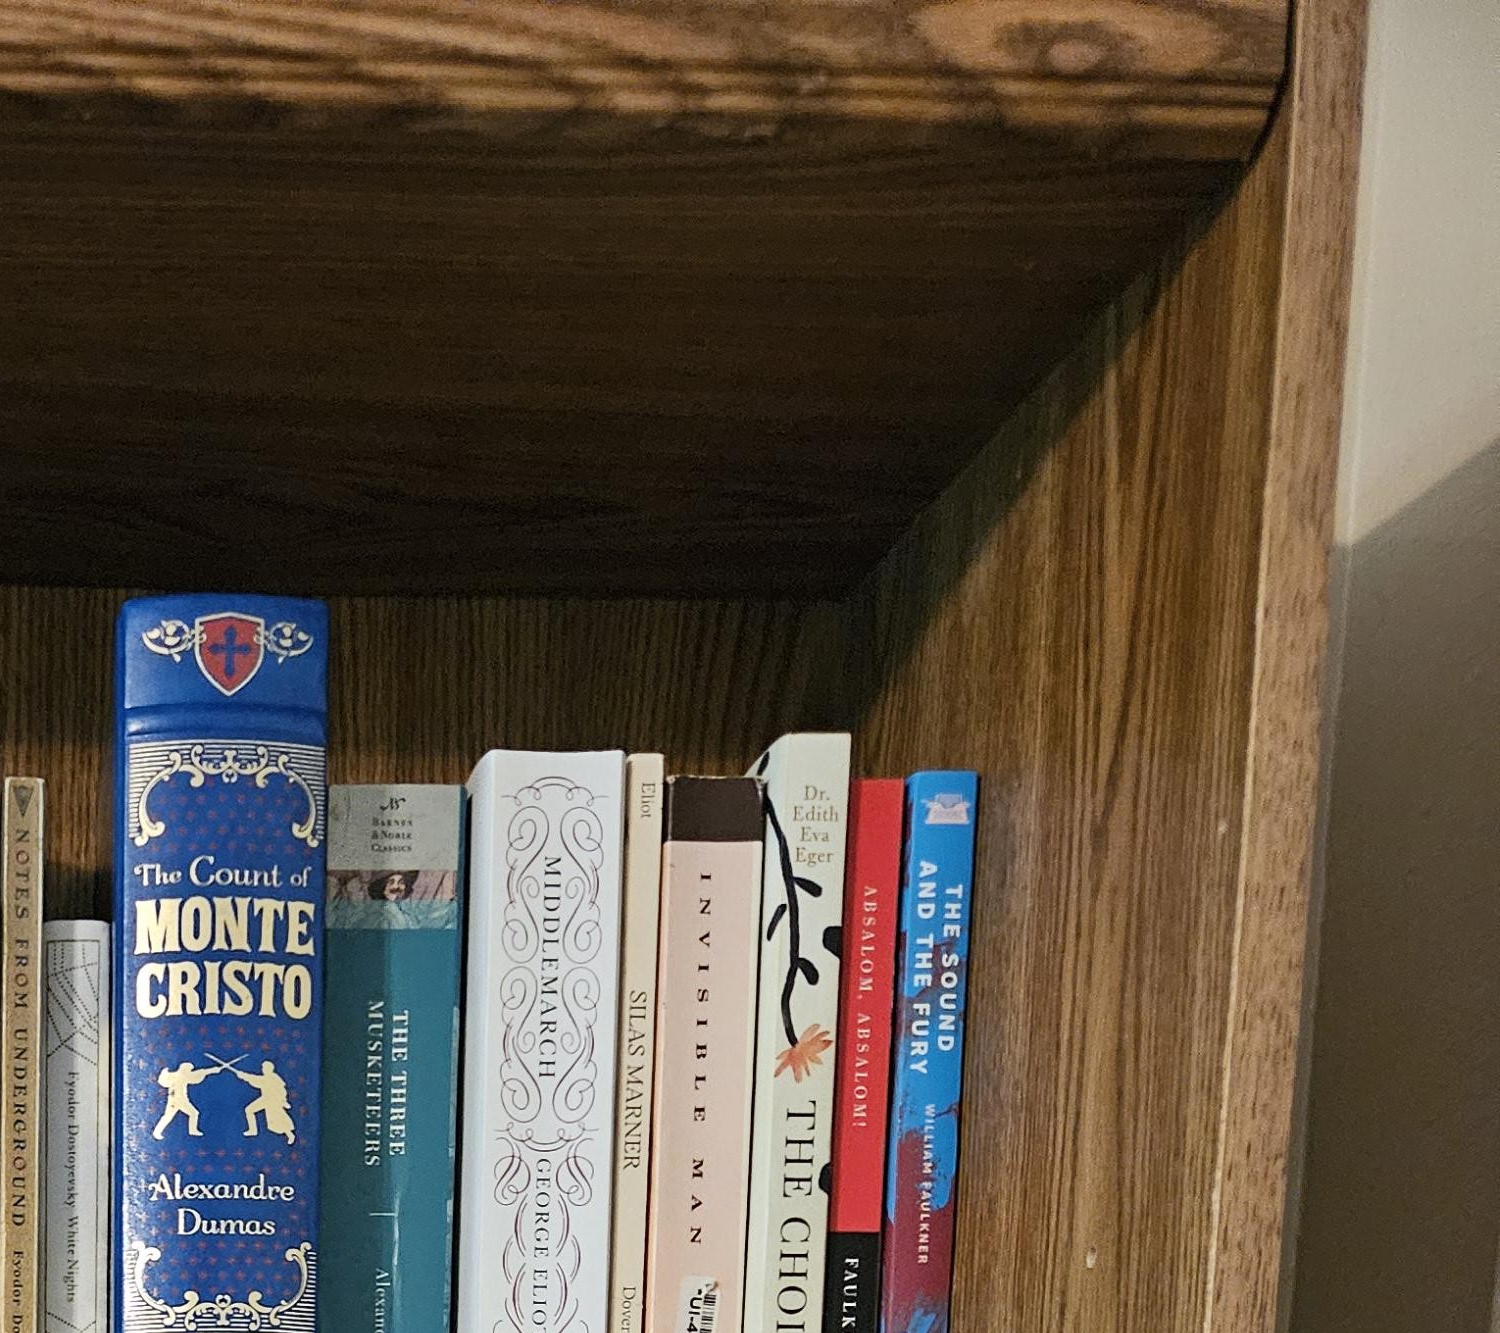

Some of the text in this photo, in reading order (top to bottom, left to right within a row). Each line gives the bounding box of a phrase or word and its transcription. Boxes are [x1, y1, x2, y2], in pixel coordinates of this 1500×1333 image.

[133, 855, 311, 887] The Count of
[134, 895, 315, 956] MONTE
[11, 830, 31, 1228] NOTES FROM UNDERGROUND
[136, 961, 312, 1020] CRISTO
[538, 856, 562, 1079] MIDDLEMARCH
[909, 860, 939, 1074] AND THE FURY
[936, 884, 964, 1051] THE SOUND
[623, 991, 648, 1170] SILAS MARNER
[690, 872, 713, 1245] INVISIBLE MAN
[63, 1071, 80, 1303] Fyodor Dostoyevsky White Nights
[148, 1174, 294, 1202] Alexandre
[531, 1158, 552, 1258] GEORGE
[781, 1100, 818, 1198] THE
[177, 1208, 276, 1235] Dumas
